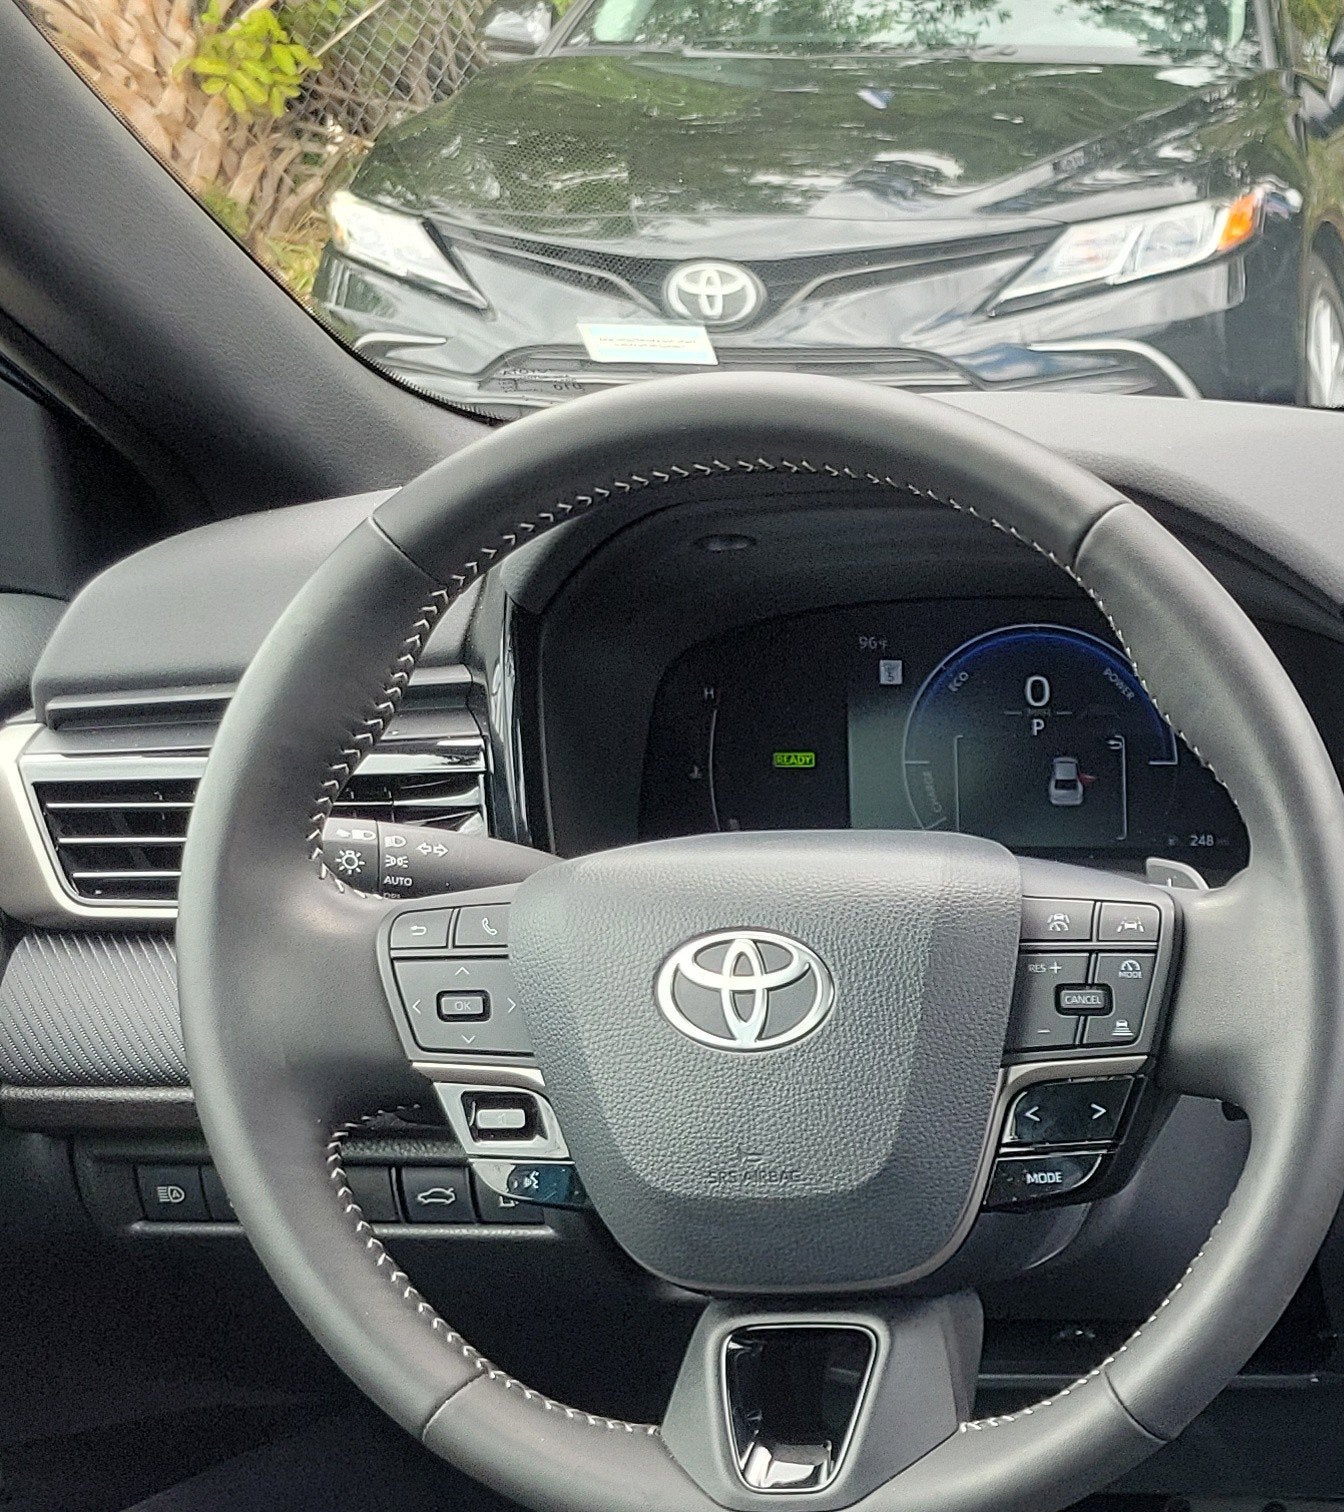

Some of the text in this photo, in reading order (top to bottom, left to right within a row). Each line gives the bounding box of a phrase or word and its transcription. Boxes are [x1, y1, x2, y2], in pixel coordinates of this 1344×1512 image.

[948, 671, 970, 693] ECO
[1102, 667, 1136, 701] POWER
[704, 687, 715, 699] H
[1032, 718, 1045, 736] P
[776, 755, 812, 766] READY
[1190, 834, 1214, 847] 248
[383, 875, 413, 887] AUTO
[1028, 963, 1047, 973] RES
[454, 1001, 472, 1011] OK
[1064, 995, 1101, 1005] CANCEL
[1026, 1171, 1063, 1184] MODE
